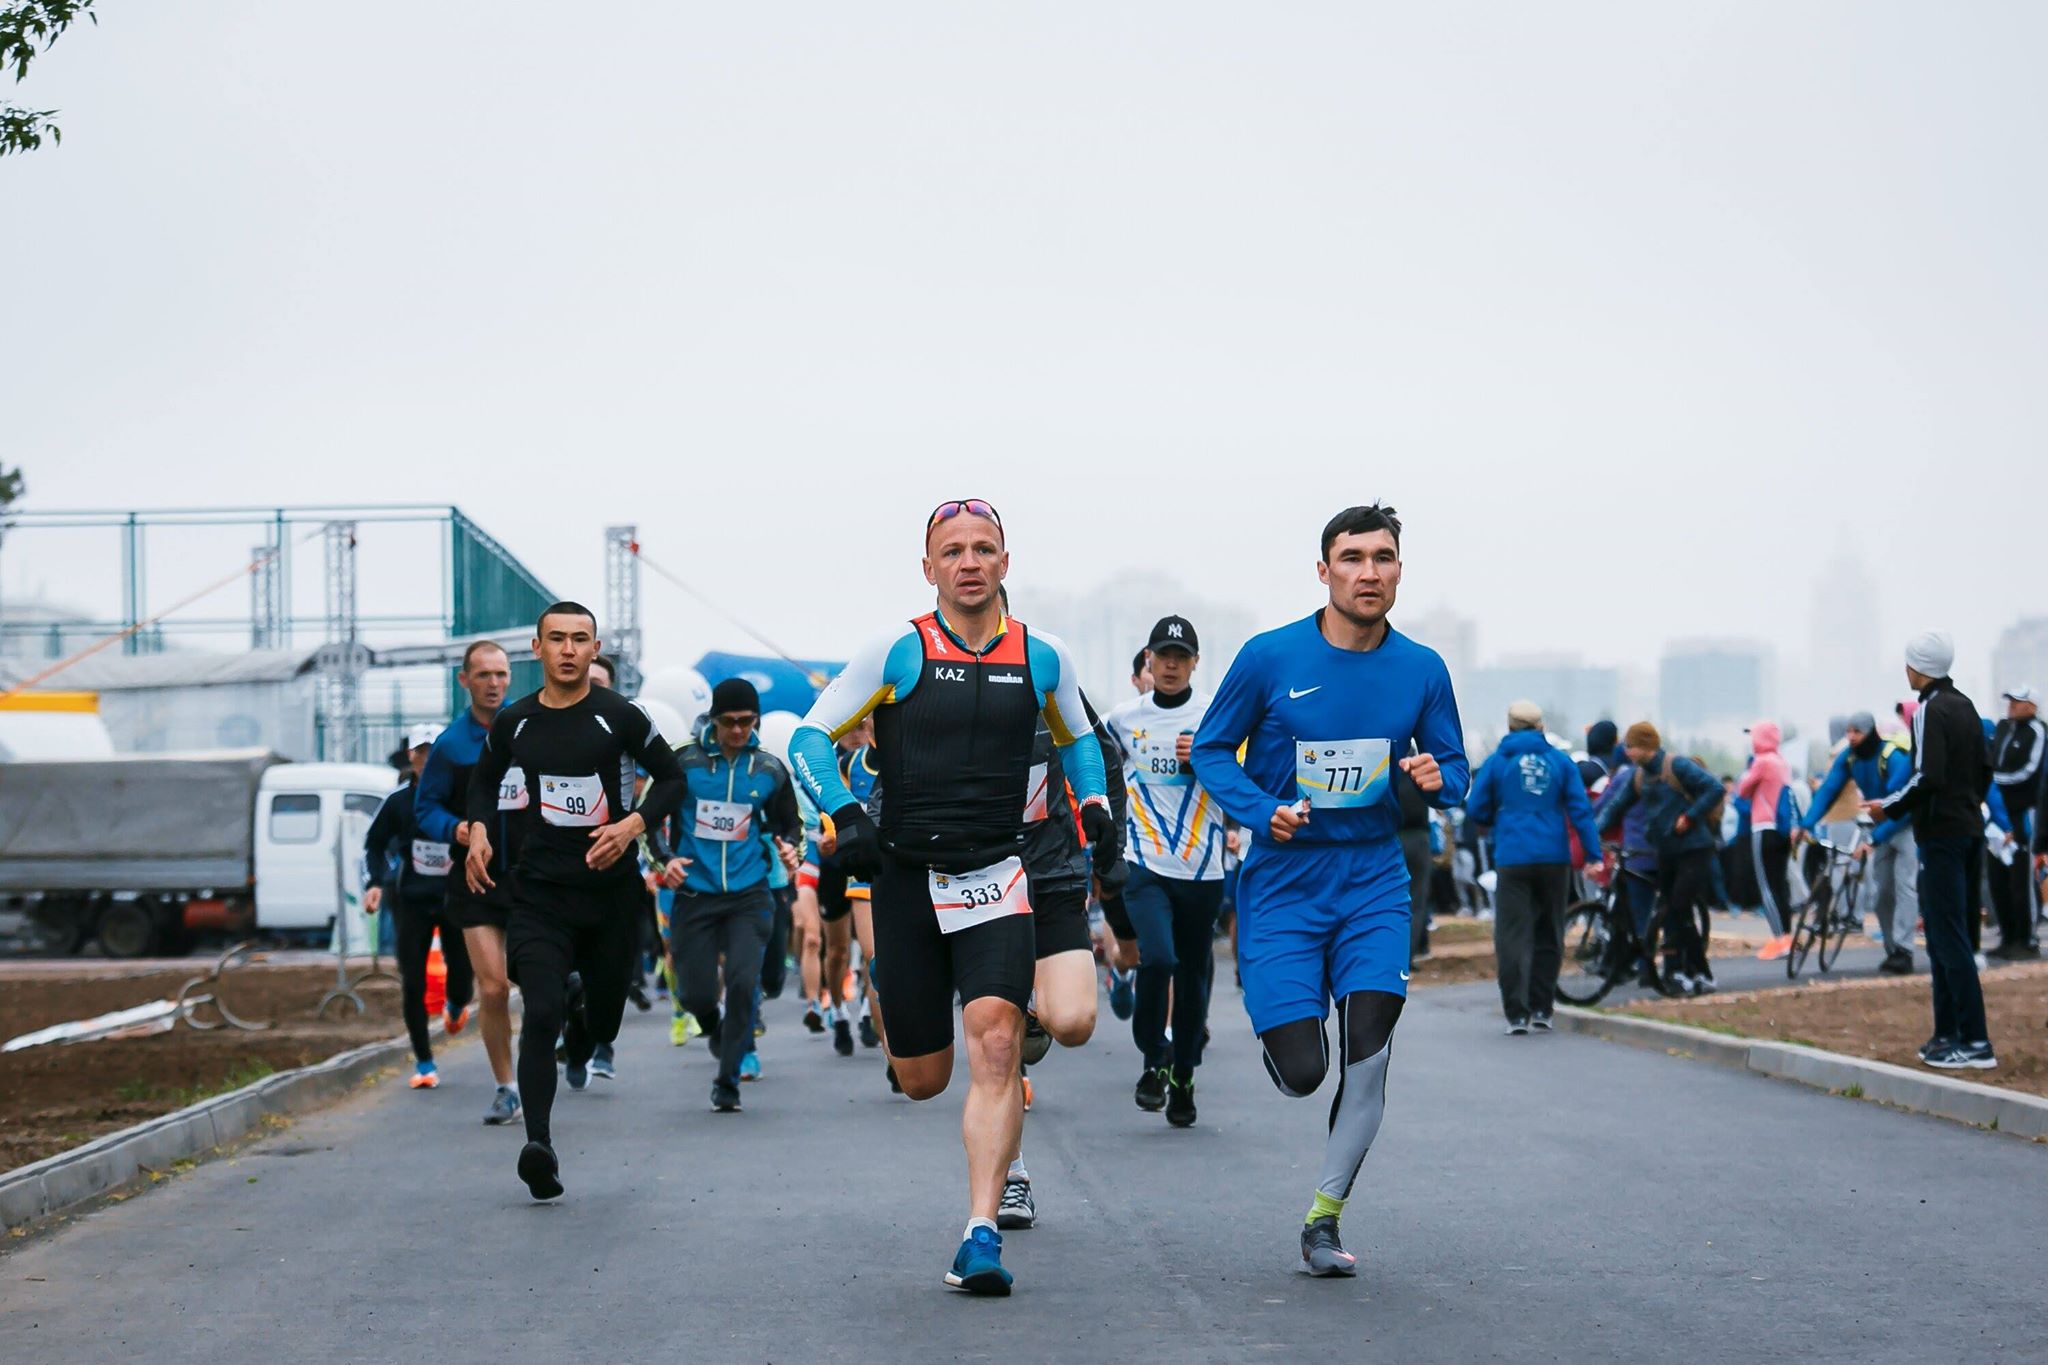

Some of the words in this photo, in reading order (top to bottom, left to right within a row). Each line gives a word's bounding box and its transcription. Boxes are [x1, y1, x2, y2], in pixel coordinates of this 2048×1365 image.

[935, 667, 965, 682] KAZ
[793, 752, 823, 798] ASTANA
[1151, 757, 1177, 775] 833
[1324, 766, 1363, 793] 777
[498, 784, 518, 800] 78
[566, 796, 586, 815] 99
[711, 816, 735, 832] 309
[960, 882, 1003, 910] 333
